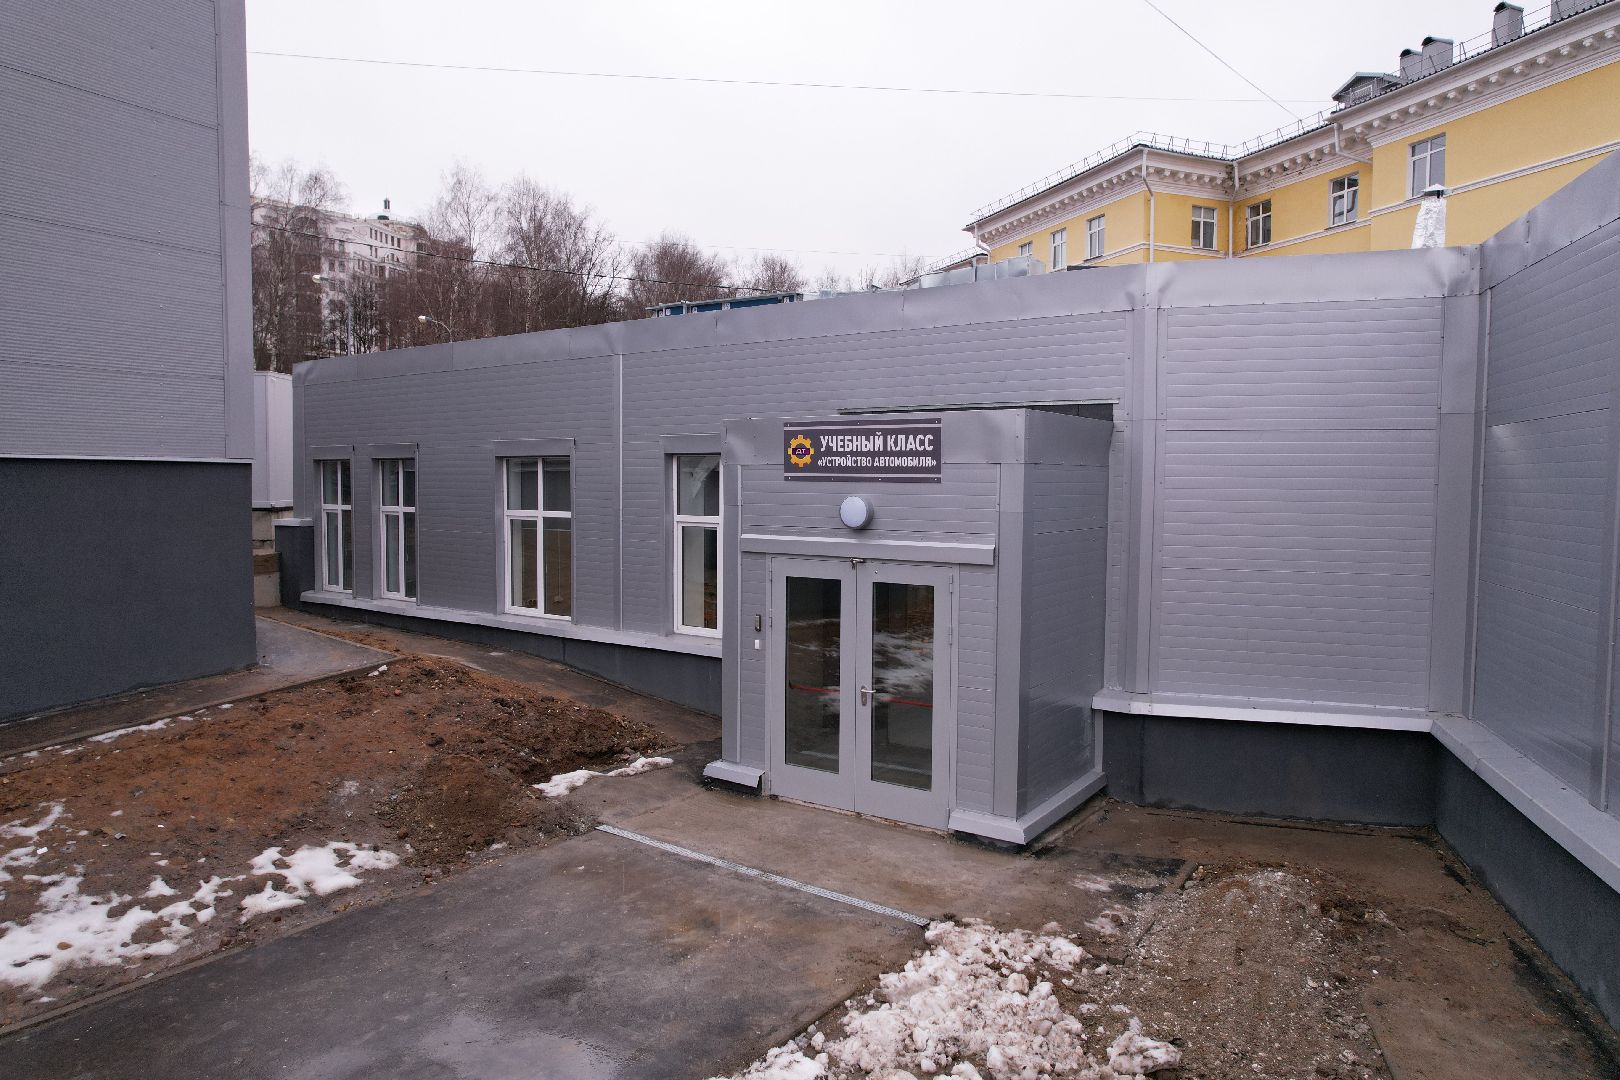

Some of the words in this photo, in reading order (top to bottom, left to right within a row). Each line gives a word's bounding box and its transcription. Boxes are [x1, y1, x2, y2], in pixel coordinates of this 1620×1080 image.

[820, 432, 883, 452] УЧЕБНЫЙ
[887, 434, 934, 451] КЛАСС
[818, 455, 872, 467] «УСТРОЙСТВО
[873, 456, 937, 467] АВТОМОБИЛЯ»
